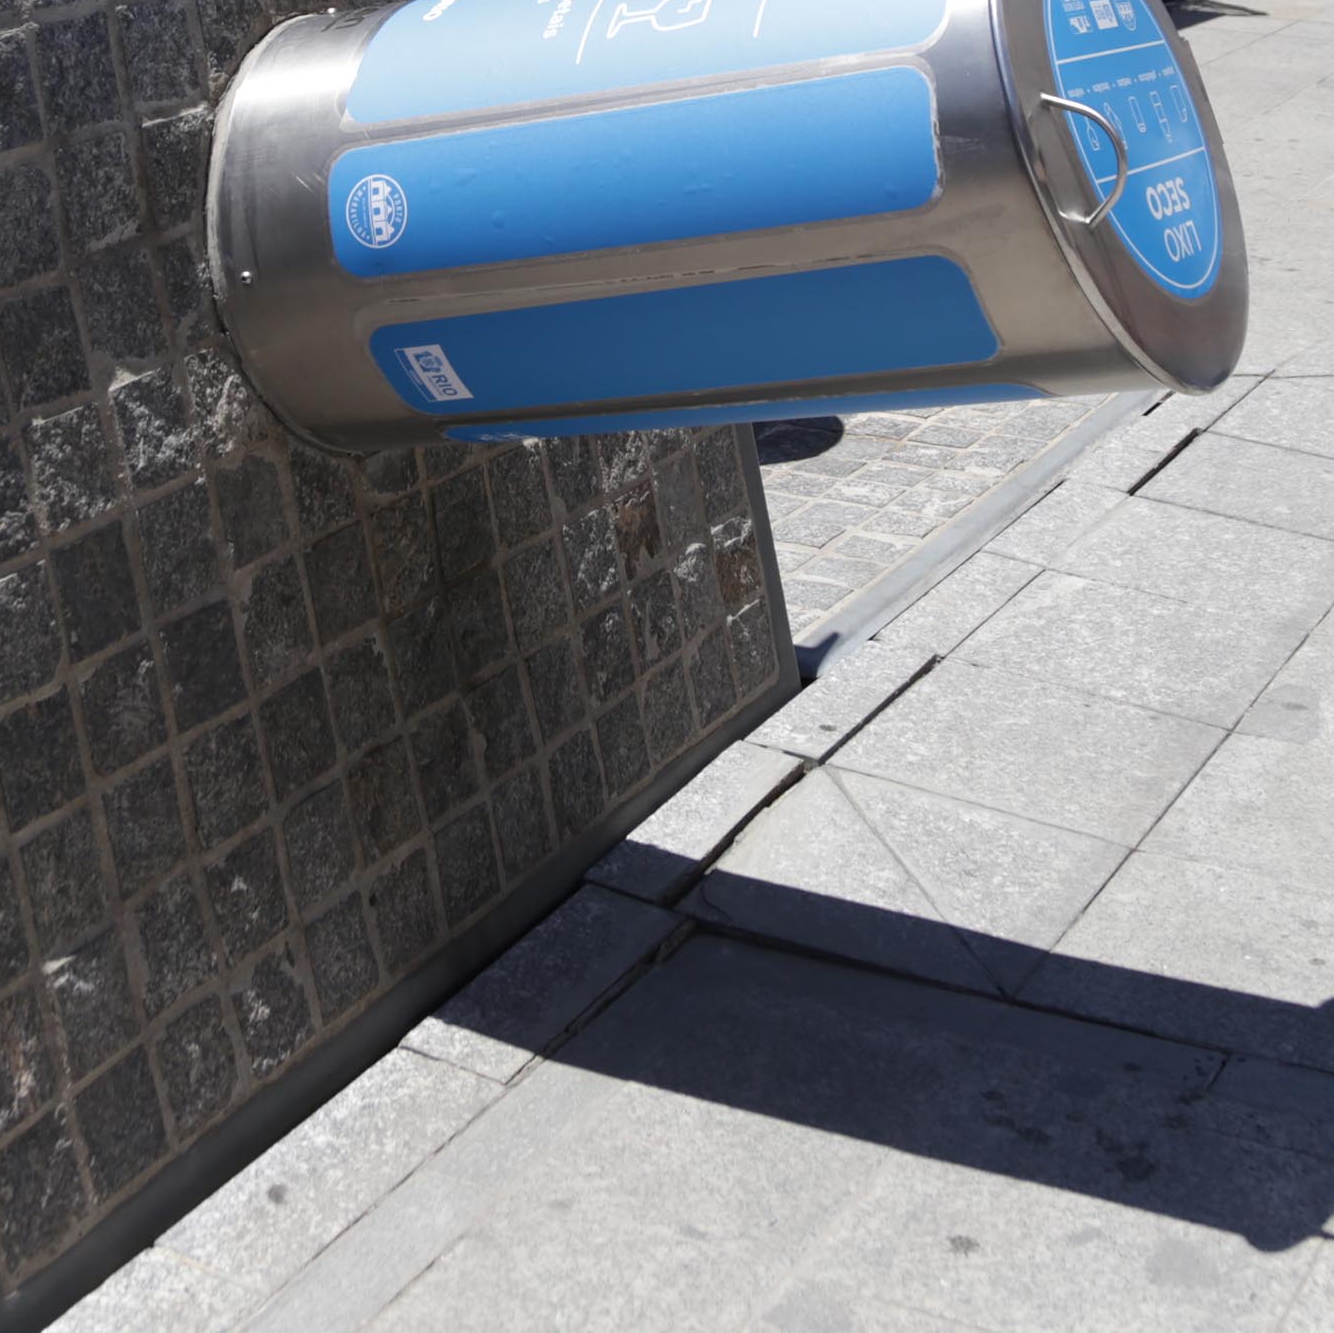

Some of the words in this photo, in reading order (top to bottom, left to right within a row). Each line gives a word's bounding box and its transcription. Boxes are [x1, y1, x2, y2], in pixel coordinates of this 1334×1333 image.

[1145, 176, 1191, 221] SECO
[1163, 220, 1203, 263] LIXO
[432, 374, 459, 397] RIO
